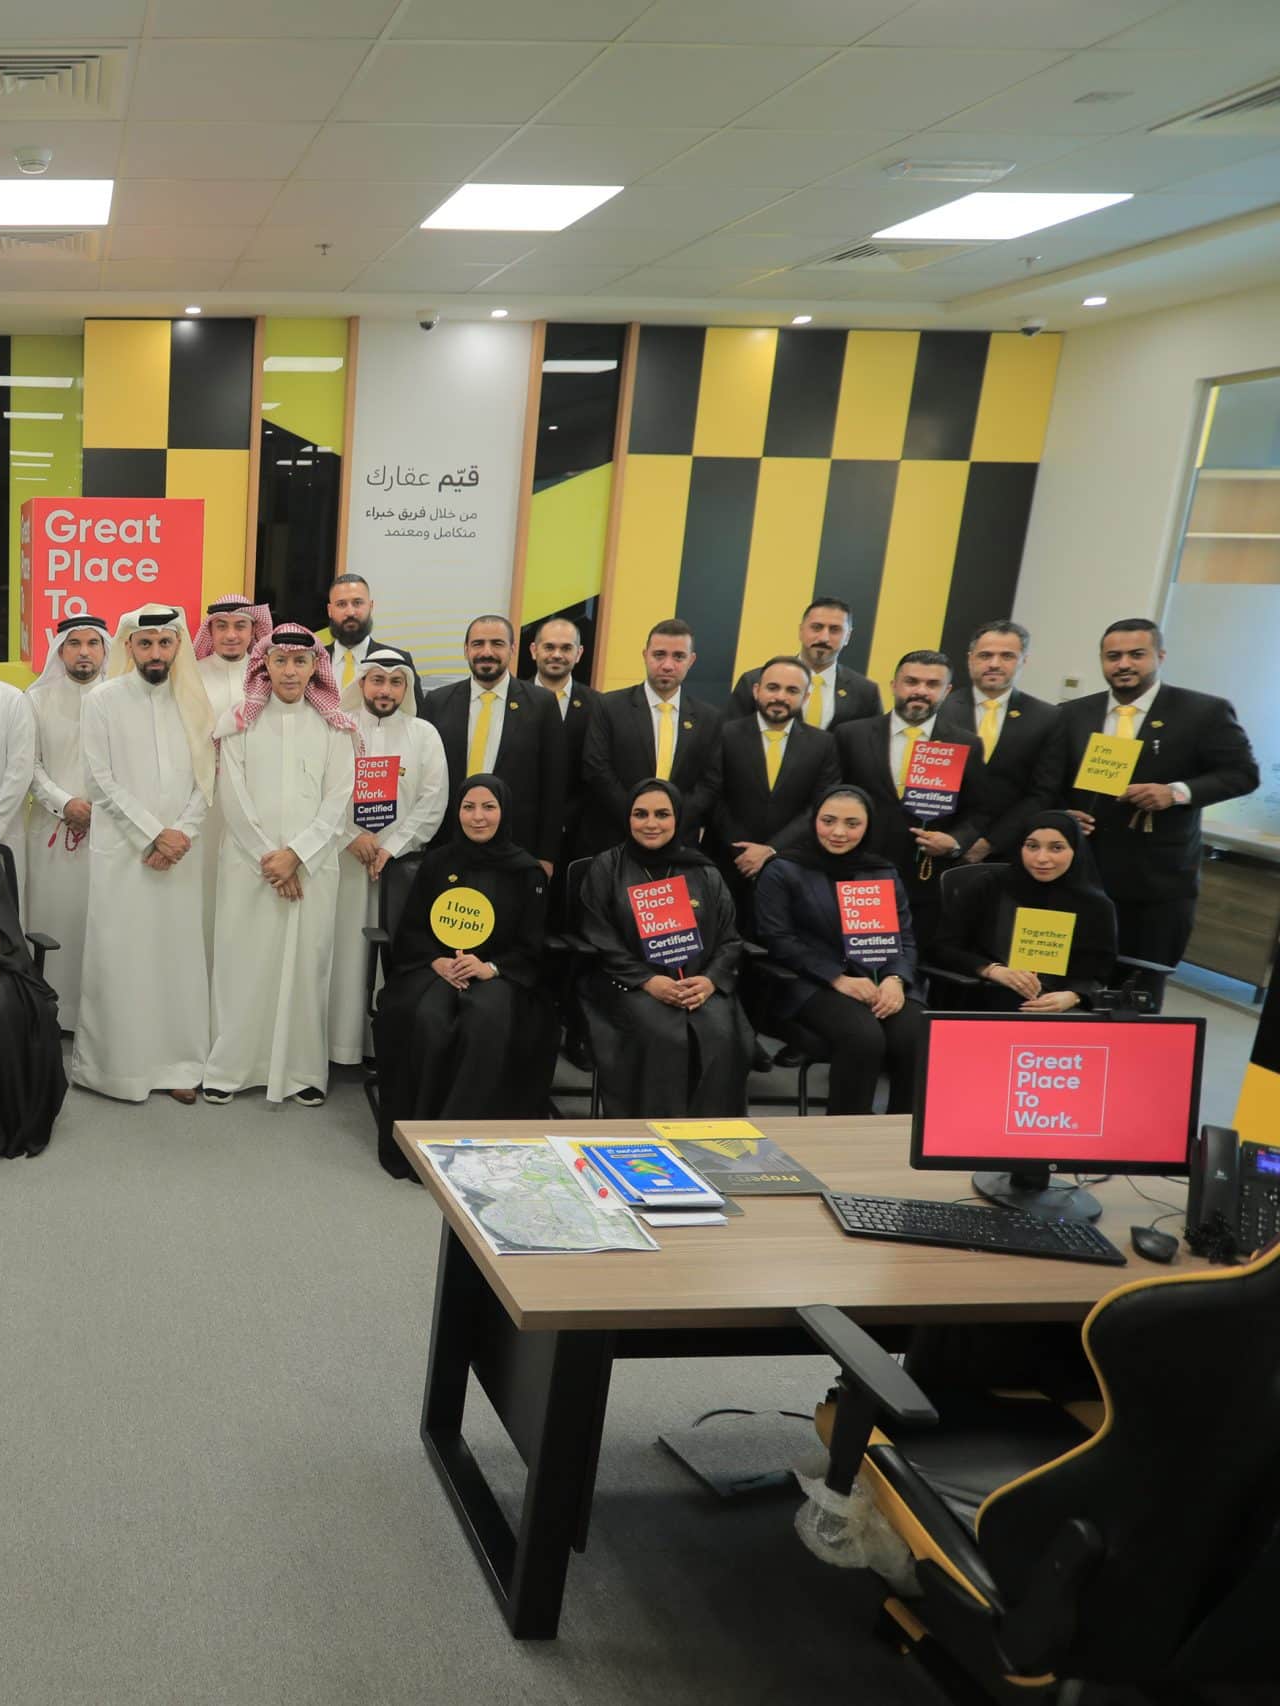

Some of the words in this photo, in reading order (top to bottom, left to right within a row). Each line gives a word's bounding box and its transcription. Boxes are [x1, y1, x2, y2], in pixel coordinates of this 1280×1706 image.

[366, 465, 431, 492] عقارك
[365, 506, 395, 521] خبراء
[398, 506, 426, 521] فريق
[429, 507, 456, 521] خلال
[459, 512, 478, 522] من
[45, 509, 161, 543] Great
[384, 527, 430, 540] ومعتمد
[433, 526, 477, 540] متكامل
[48, 549, 159, 583] Place
[44, 589, 88, 620] To
[916, 744, 955, 756] Great
[357, 760, 389, 769] Great
[914, 754, 951, 766] Place
[1090, 756, 1128, 769] always
[357, 769, 388, 778] Place
[911, 764, 926, 774] To
[356, 779, 368, 789] To
[907, 790, 953, 802] Certified
[357, 804, 393, 814] Certified
[633, 883, 672, 899] Great
[841, 885, 880, 895] Great
[636, 896, 675, 911] Place
[843, 896, 881, 906] Place
[447, 901, 452, 910] I
[455, 902, 480, 917] love
[843, 908, 860, 918] To
[440, 915, 457, 928] my
[458, 918, 485, 932] job!
[639, 912, 654, 922] To
[1022, 928, 1067, 938] Together
[648, 932, 694, 949] Certified
[849, 935, 896, 946] Certified
[1037, 940, 1064, 948] make
[1017, 1052, 1083, 1070] Great
[1017, 1071, 1080, 1089] Place
[1015, 1091, 1040, 1107] To
